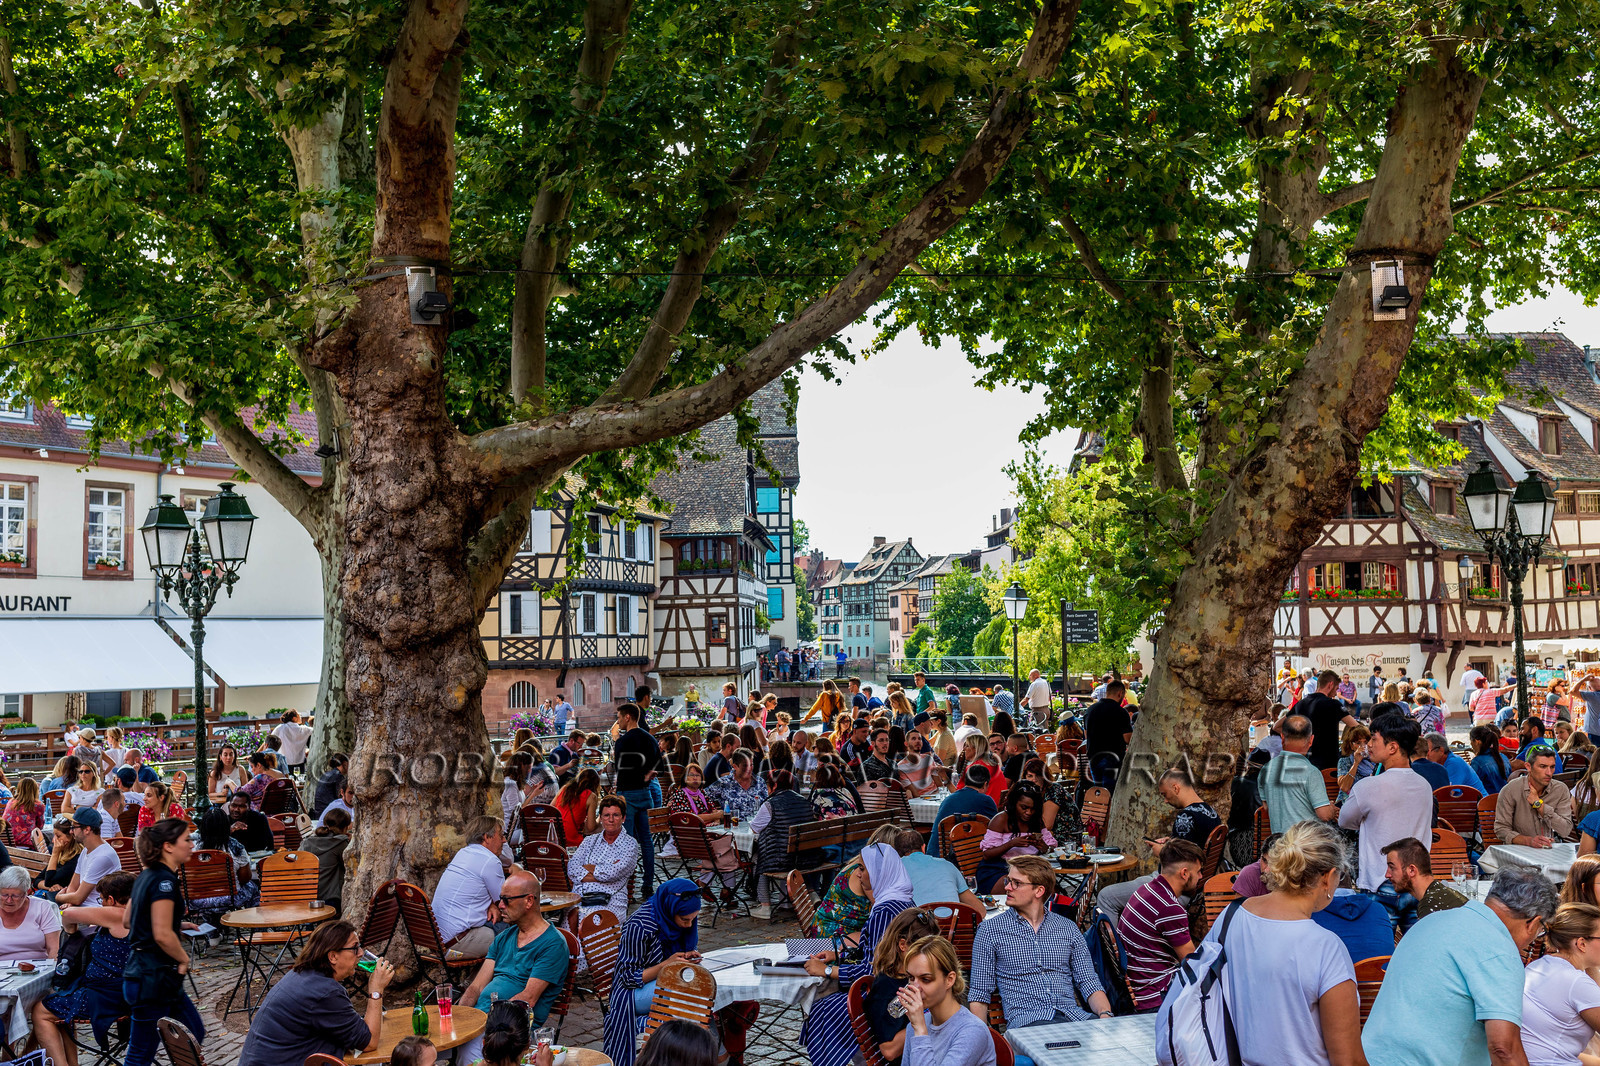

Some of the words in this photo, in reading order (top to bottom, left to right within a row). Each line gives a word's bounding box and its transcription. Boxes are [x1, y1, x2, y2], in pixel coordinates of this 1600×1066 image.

[1316, 653, 1350, 669] Maison
[1350, 654, 1365, 666] des
[1365, 651, 1411, 667] Tanneurs
